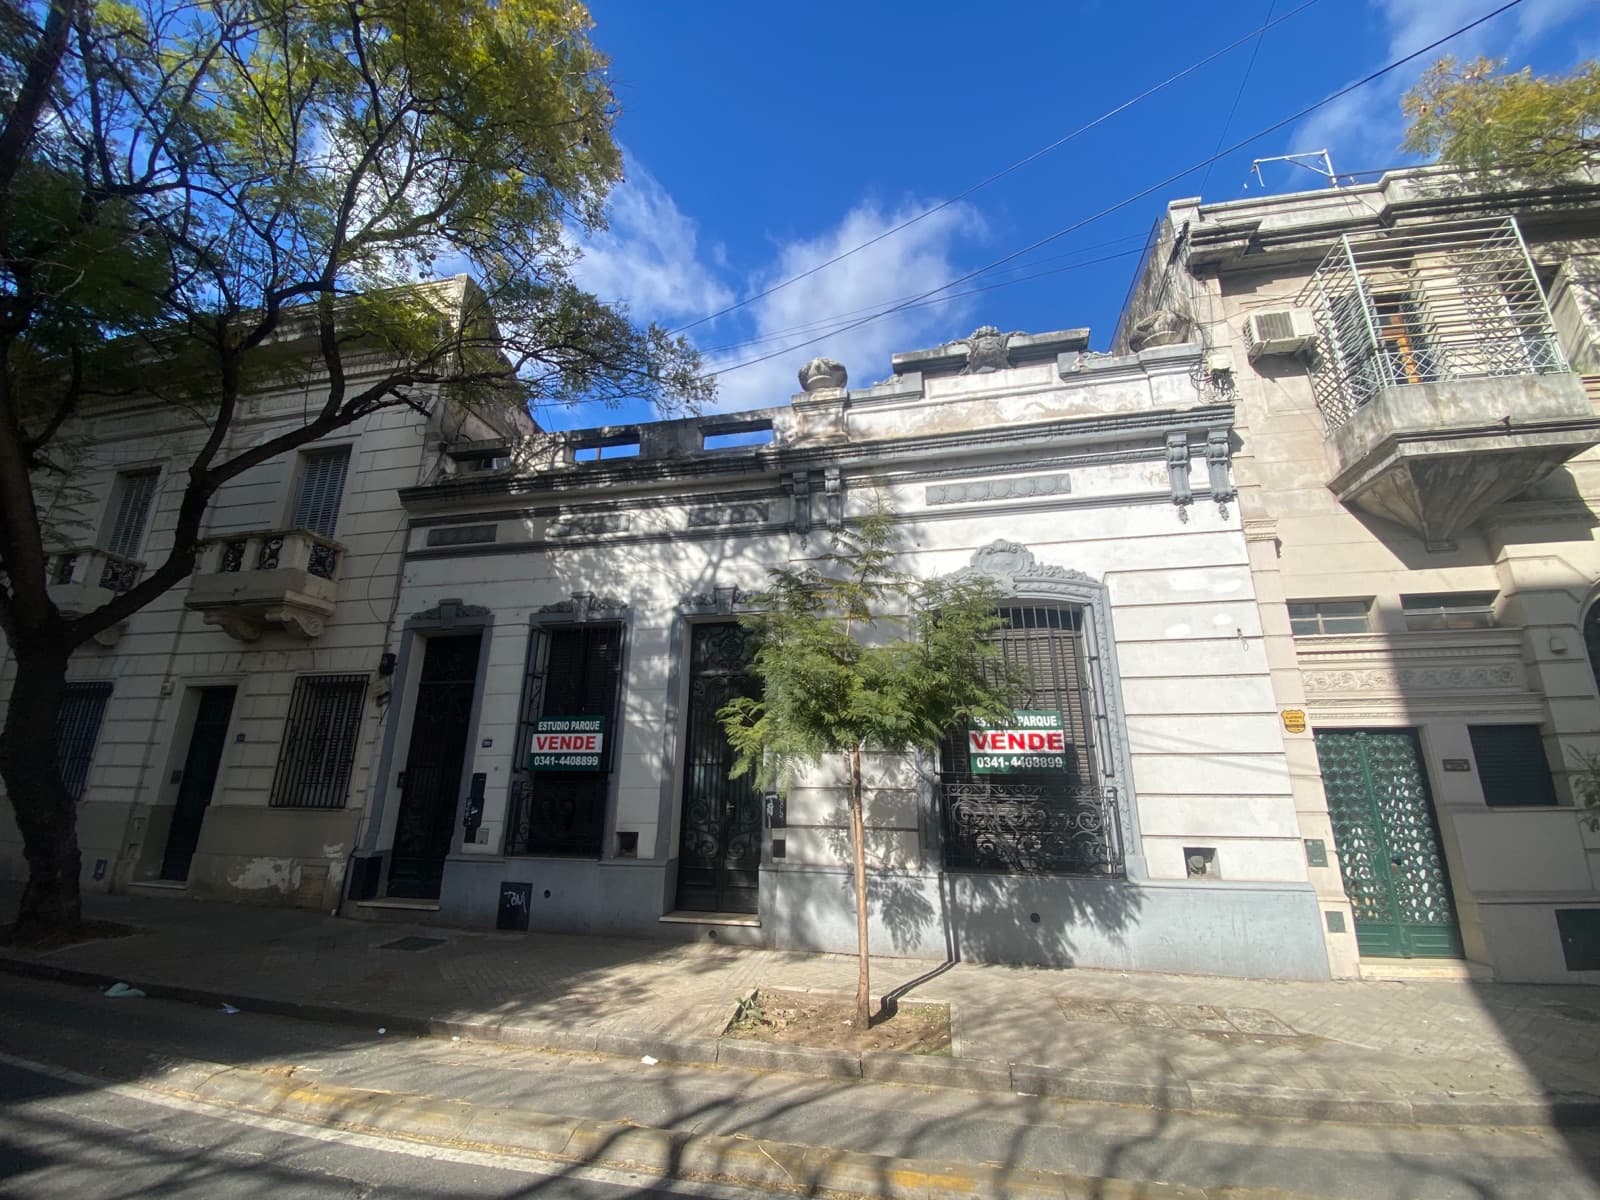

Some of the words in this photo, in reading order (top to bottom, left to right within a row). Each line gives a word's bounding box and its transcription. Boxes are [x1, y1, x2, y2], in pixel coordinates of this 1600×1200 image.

[538, 721, 569, 730] ESTUDIO
[571, 720, 600, 730] PARQUE
[1018, 715, 1057, 727] PARQUE
[536, 735, 597, 751] VENDE
[971, 733, 1063, 750] VENDE
[534, 756, 598, 766] 0341-4408899
[976, 756, 1063, 768] 0341-4408899
